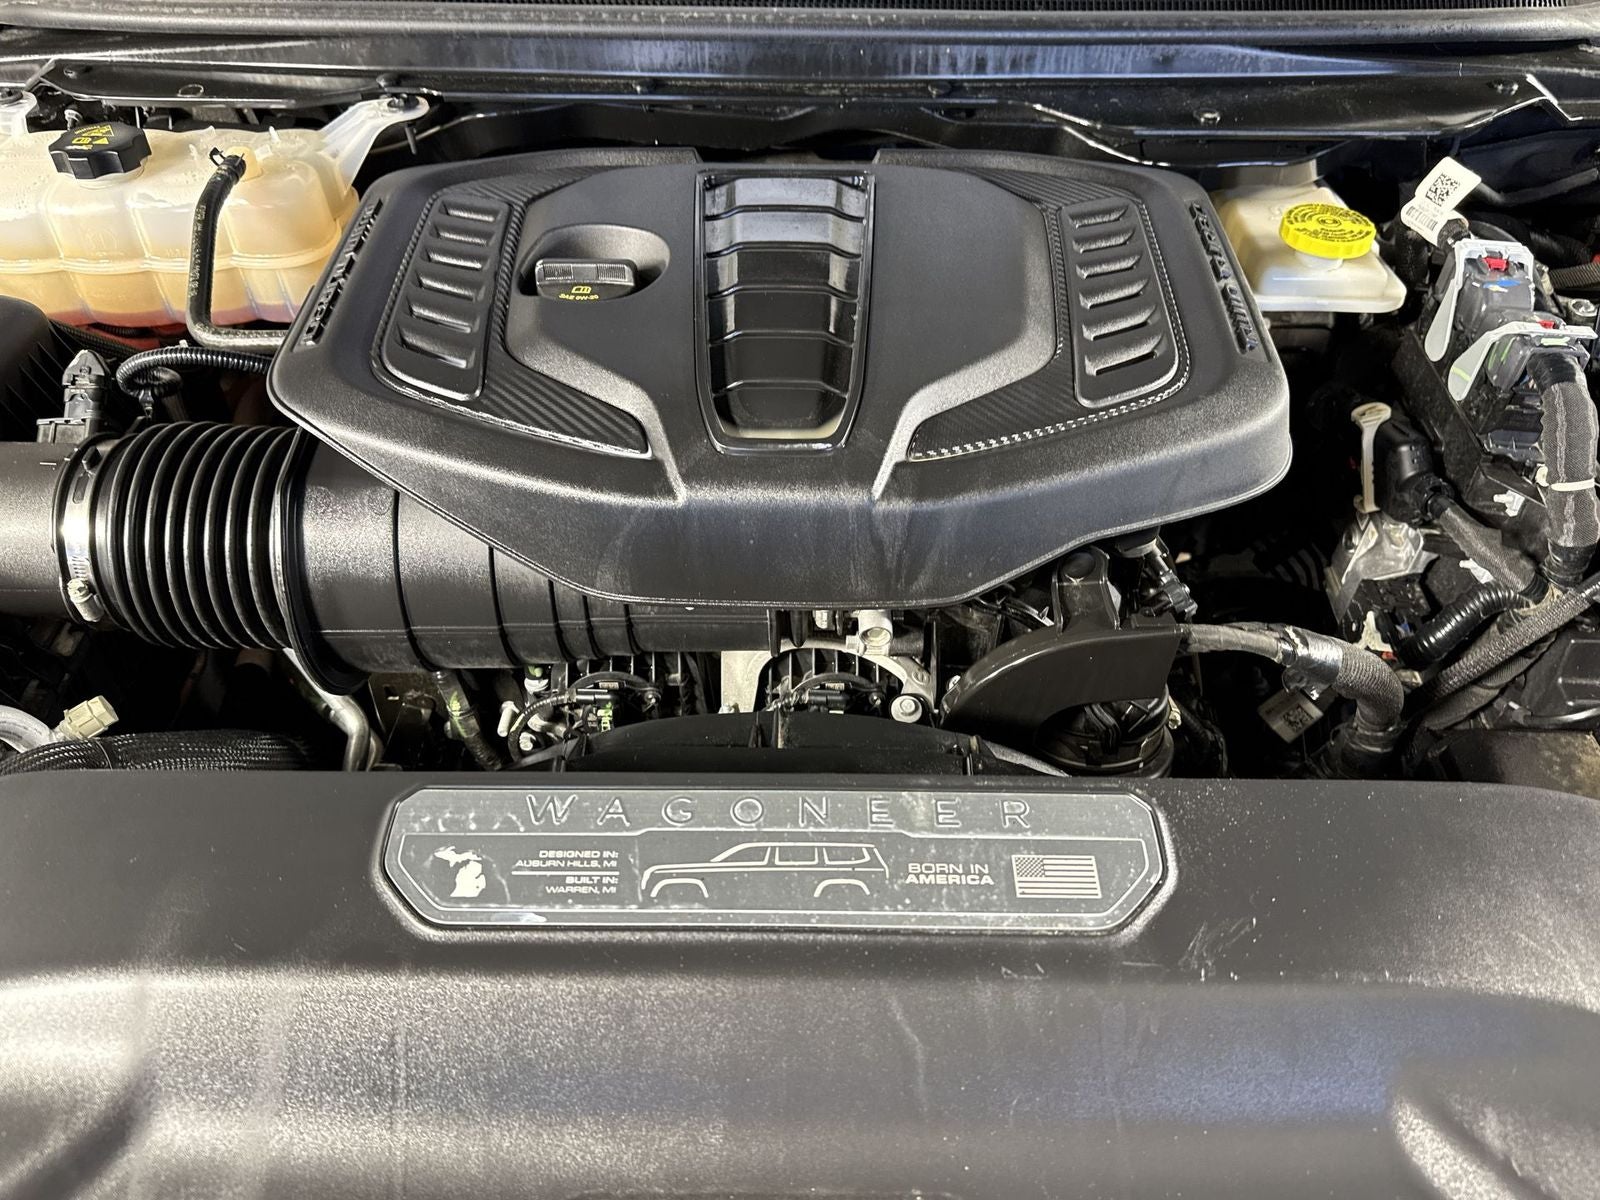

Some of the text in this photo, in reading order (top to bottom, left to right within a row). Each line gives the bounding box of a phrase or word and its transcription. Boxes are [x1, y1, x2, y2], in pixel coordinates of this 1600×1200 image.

[526, 794, 1031, 829] WAGONEER
[539, 850, 619, 858] DESIGNED IN:
[567, 860, 602, 868] HILLS,
[908, 863, 988, 873] BORN IN
[565, 876, 619, 884] BUILT IN:
[905, 874, 995, 885] AMERICA
[545, 886, 617, 894] WARREN, MI
